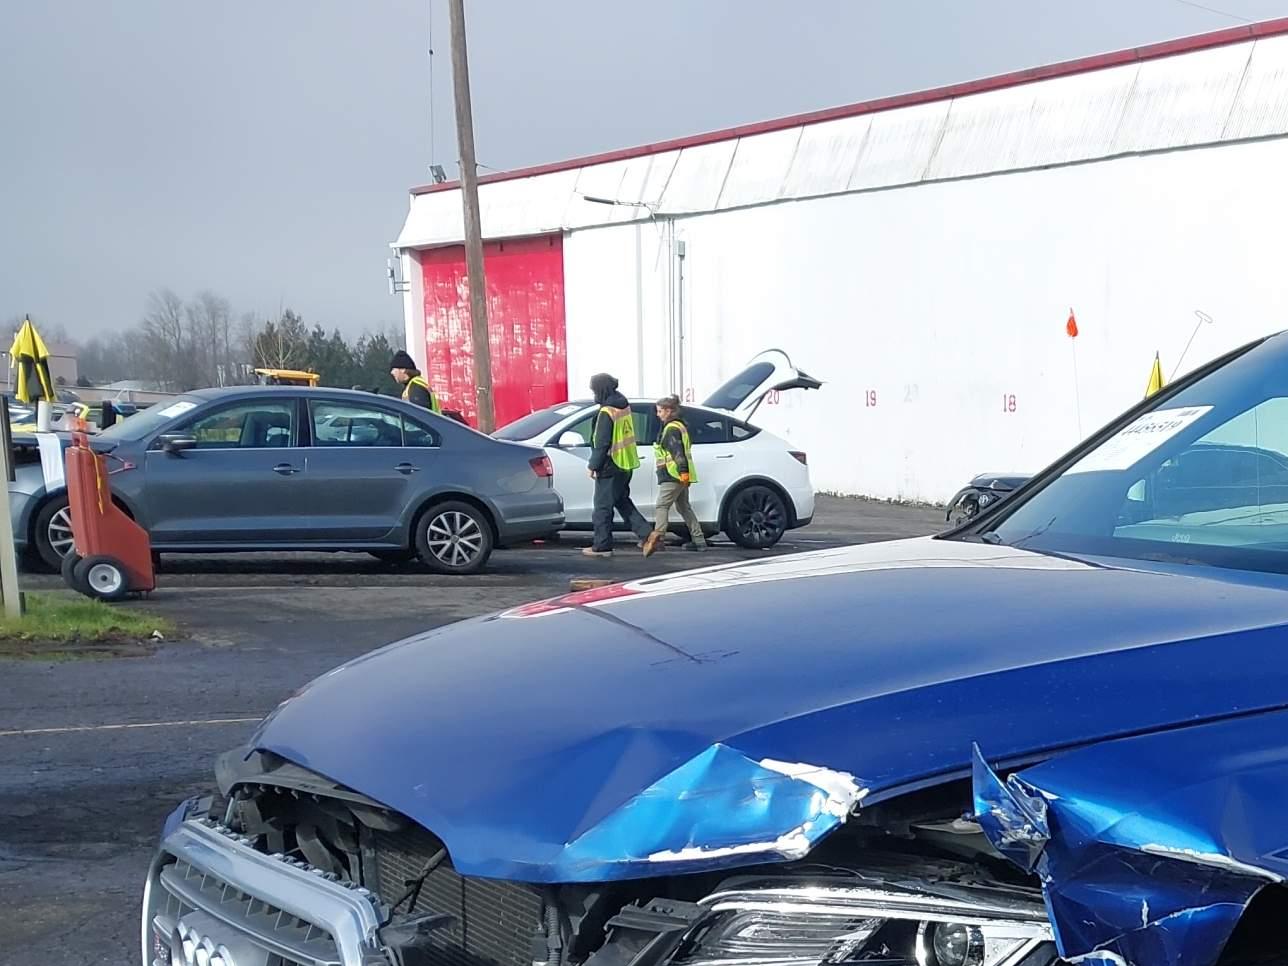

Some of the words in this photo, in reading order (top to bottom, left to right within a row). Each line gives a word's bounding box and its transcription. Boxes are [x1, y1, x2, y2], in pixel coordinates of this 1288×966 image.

[686, 388, 695, 402] 21
[767, 391, 780, 404] 20
[865, 390, 877, 407] 19
[1003, 394, 1017, 413] 18
